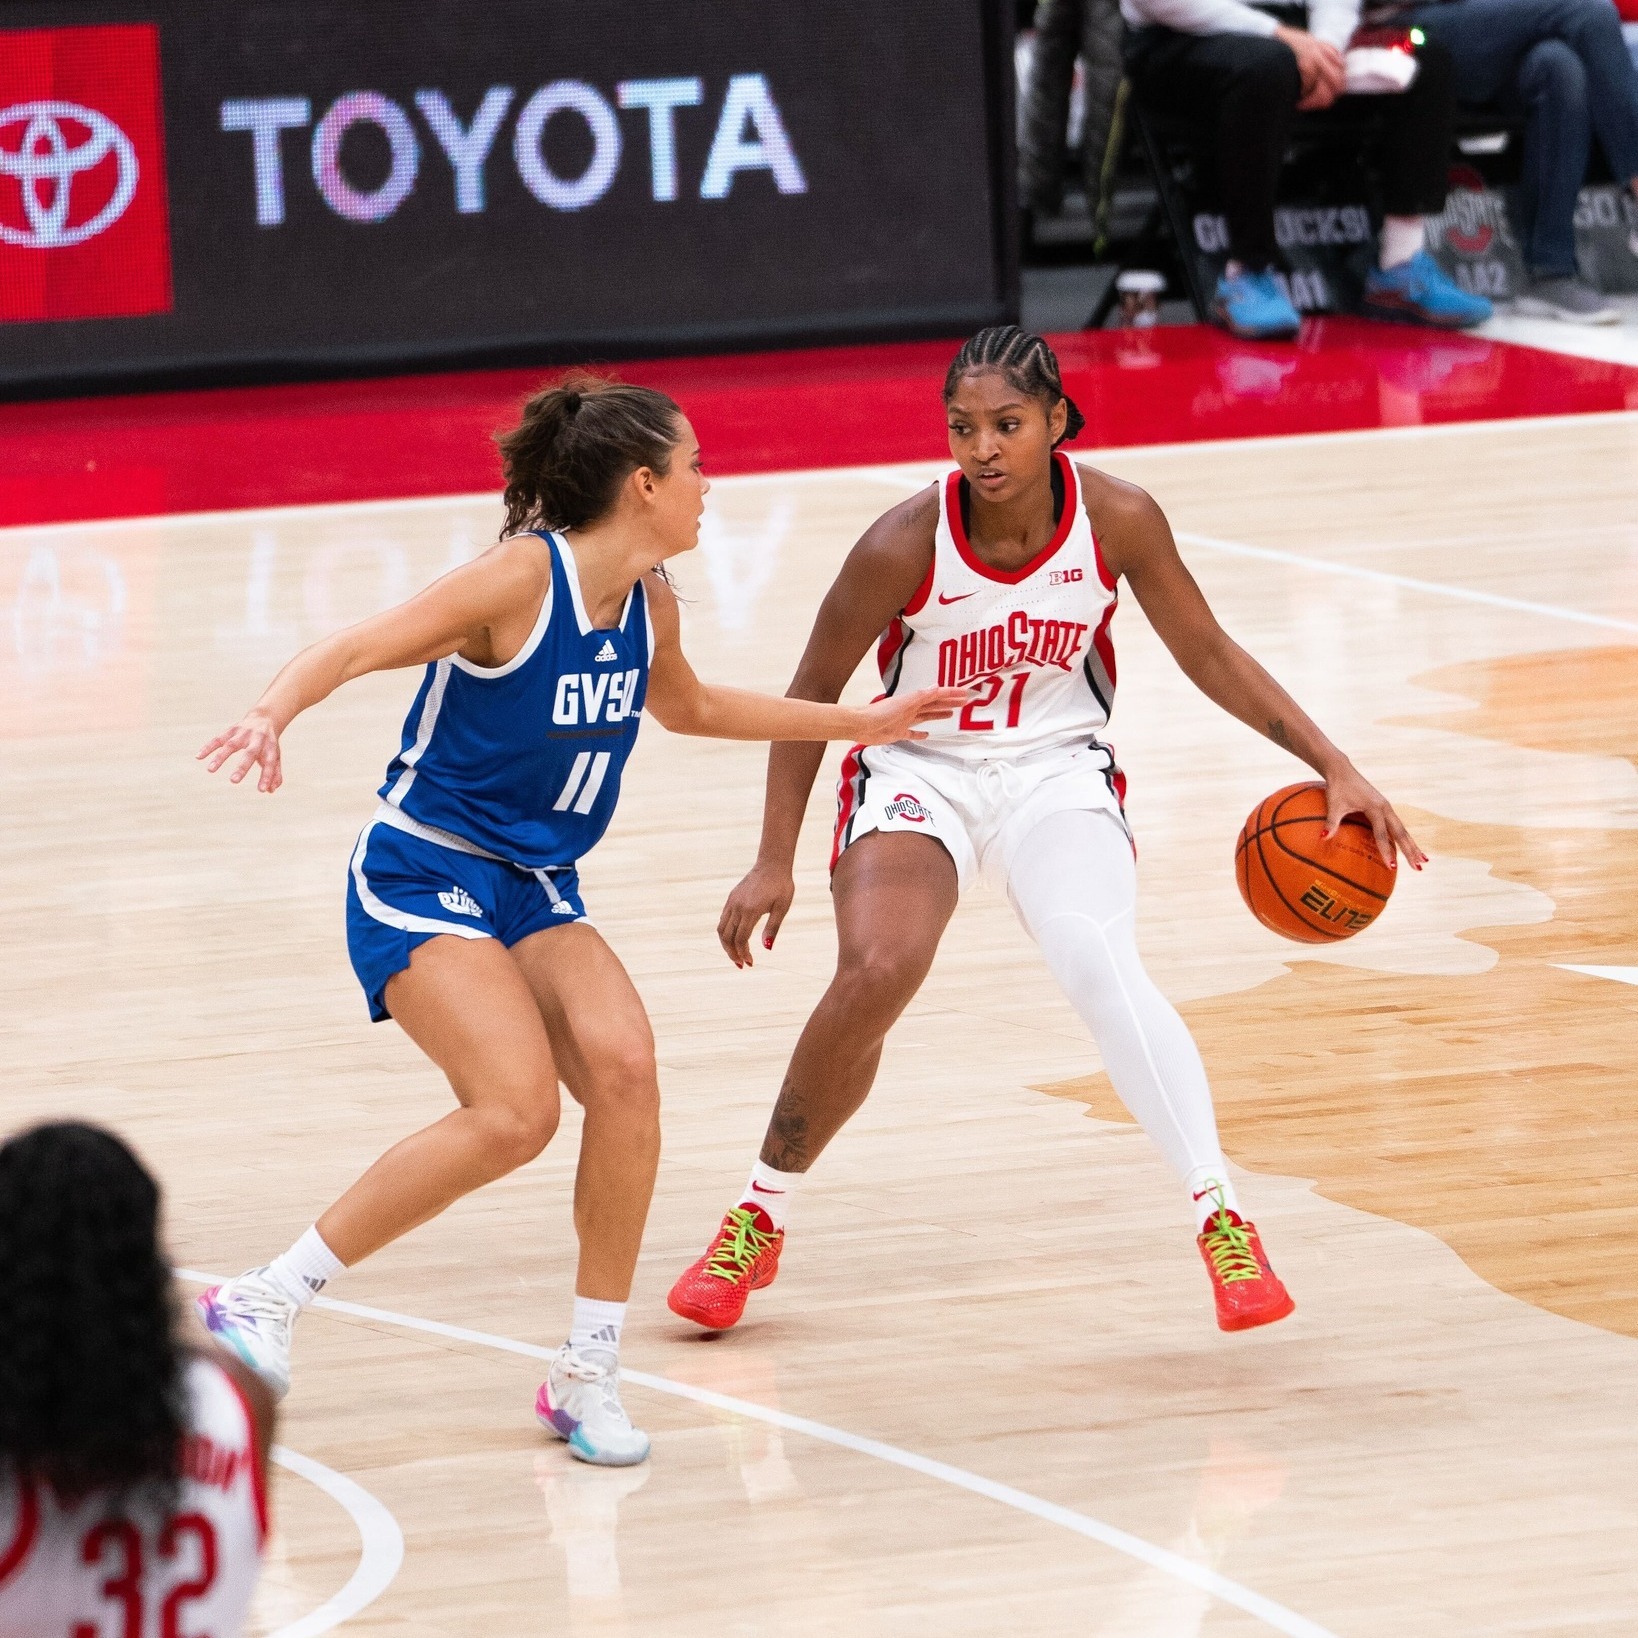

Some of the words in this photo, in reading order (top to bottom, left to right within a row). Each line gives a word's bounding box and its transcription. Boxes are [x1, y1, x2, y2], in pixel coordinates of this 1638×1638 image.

[220, 73, 808, 227] TOYOTA
[938, 624, 1005, 688] OHIO
[1004, 610, 1088, 672] STATE
[552, 668, 640, 725] GVSU
[958, 671, 1031, 731] 21
[552, 751, 611, 815] 11
[1300, 885, 1374, 930] ELITE
[68, 1512, 218, 1638] 32
